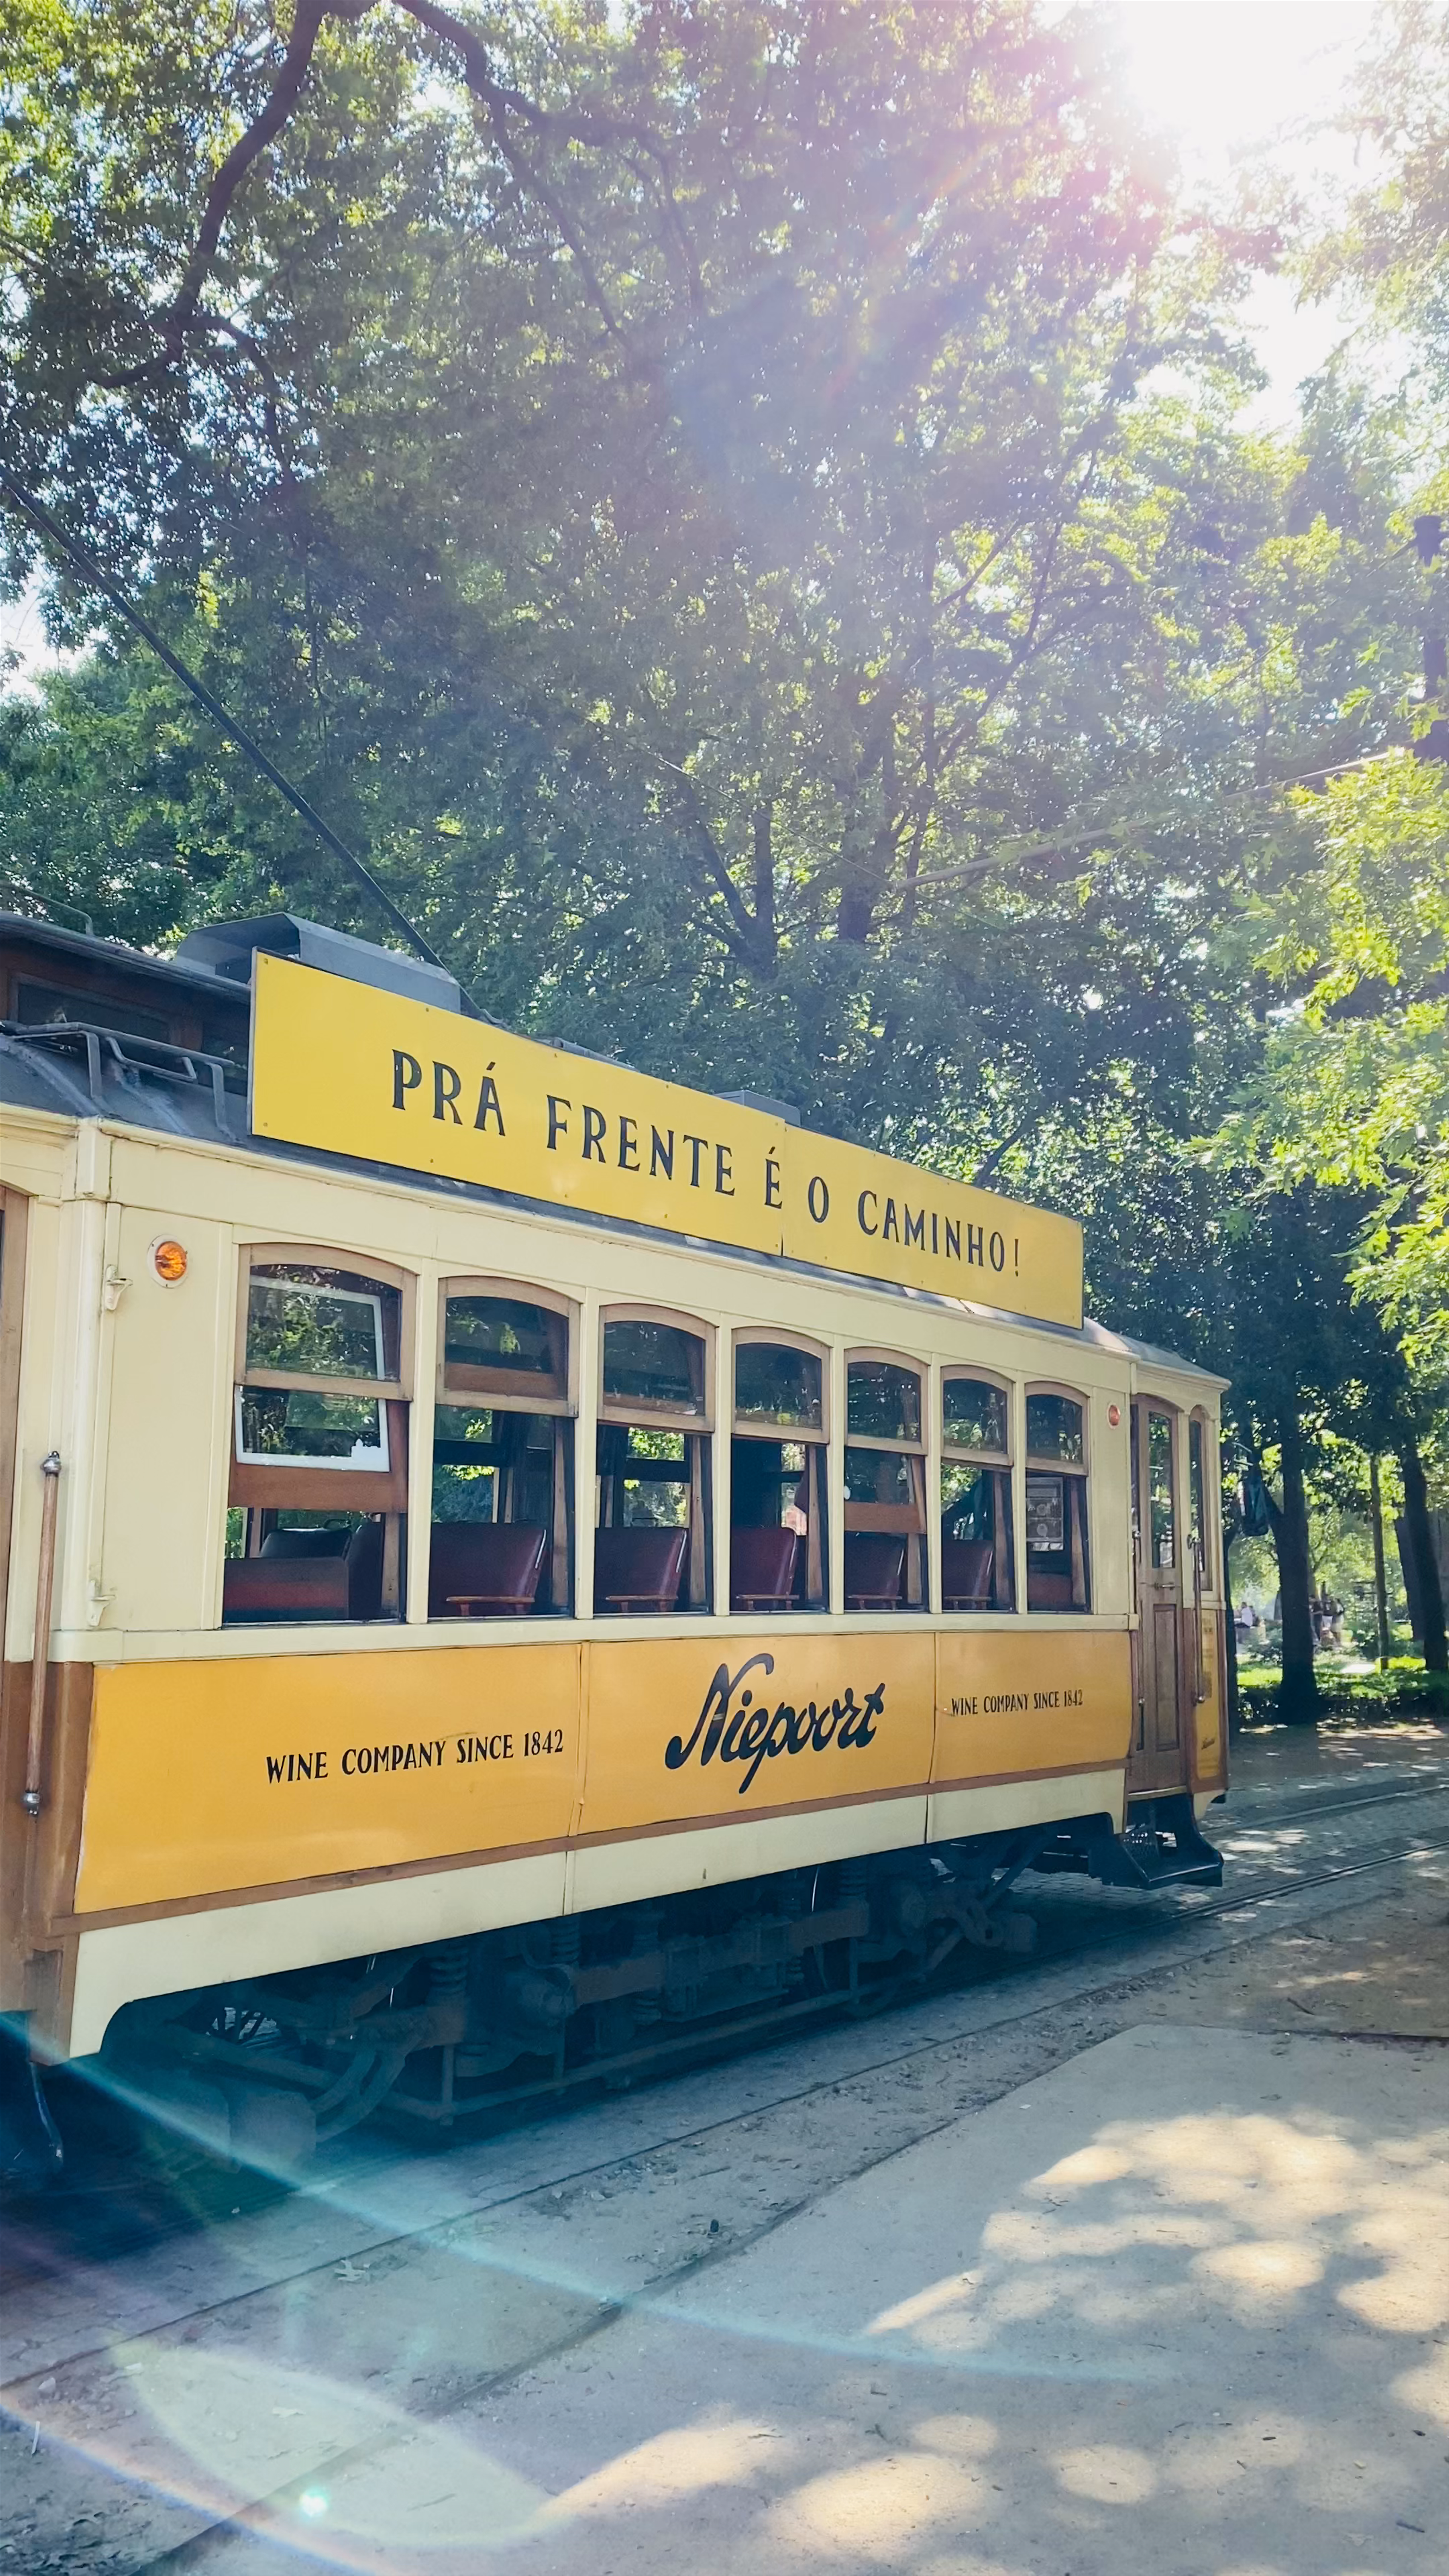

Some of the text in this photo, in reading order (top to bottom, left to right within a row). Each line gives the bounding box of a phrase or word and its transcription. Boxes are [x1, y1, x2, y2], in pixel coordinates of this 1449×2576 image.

[391, 1049, 1019, 1277] PRÁ FRENTE É O CAMINHO!
[665, 1653, 886, 1795] Niepoort
[951, 1689, 1083, 1717] WINE COMPANY SINCE 1842
[266, 1729, 564, 1784] WINE COMPANY SINCE 1842
